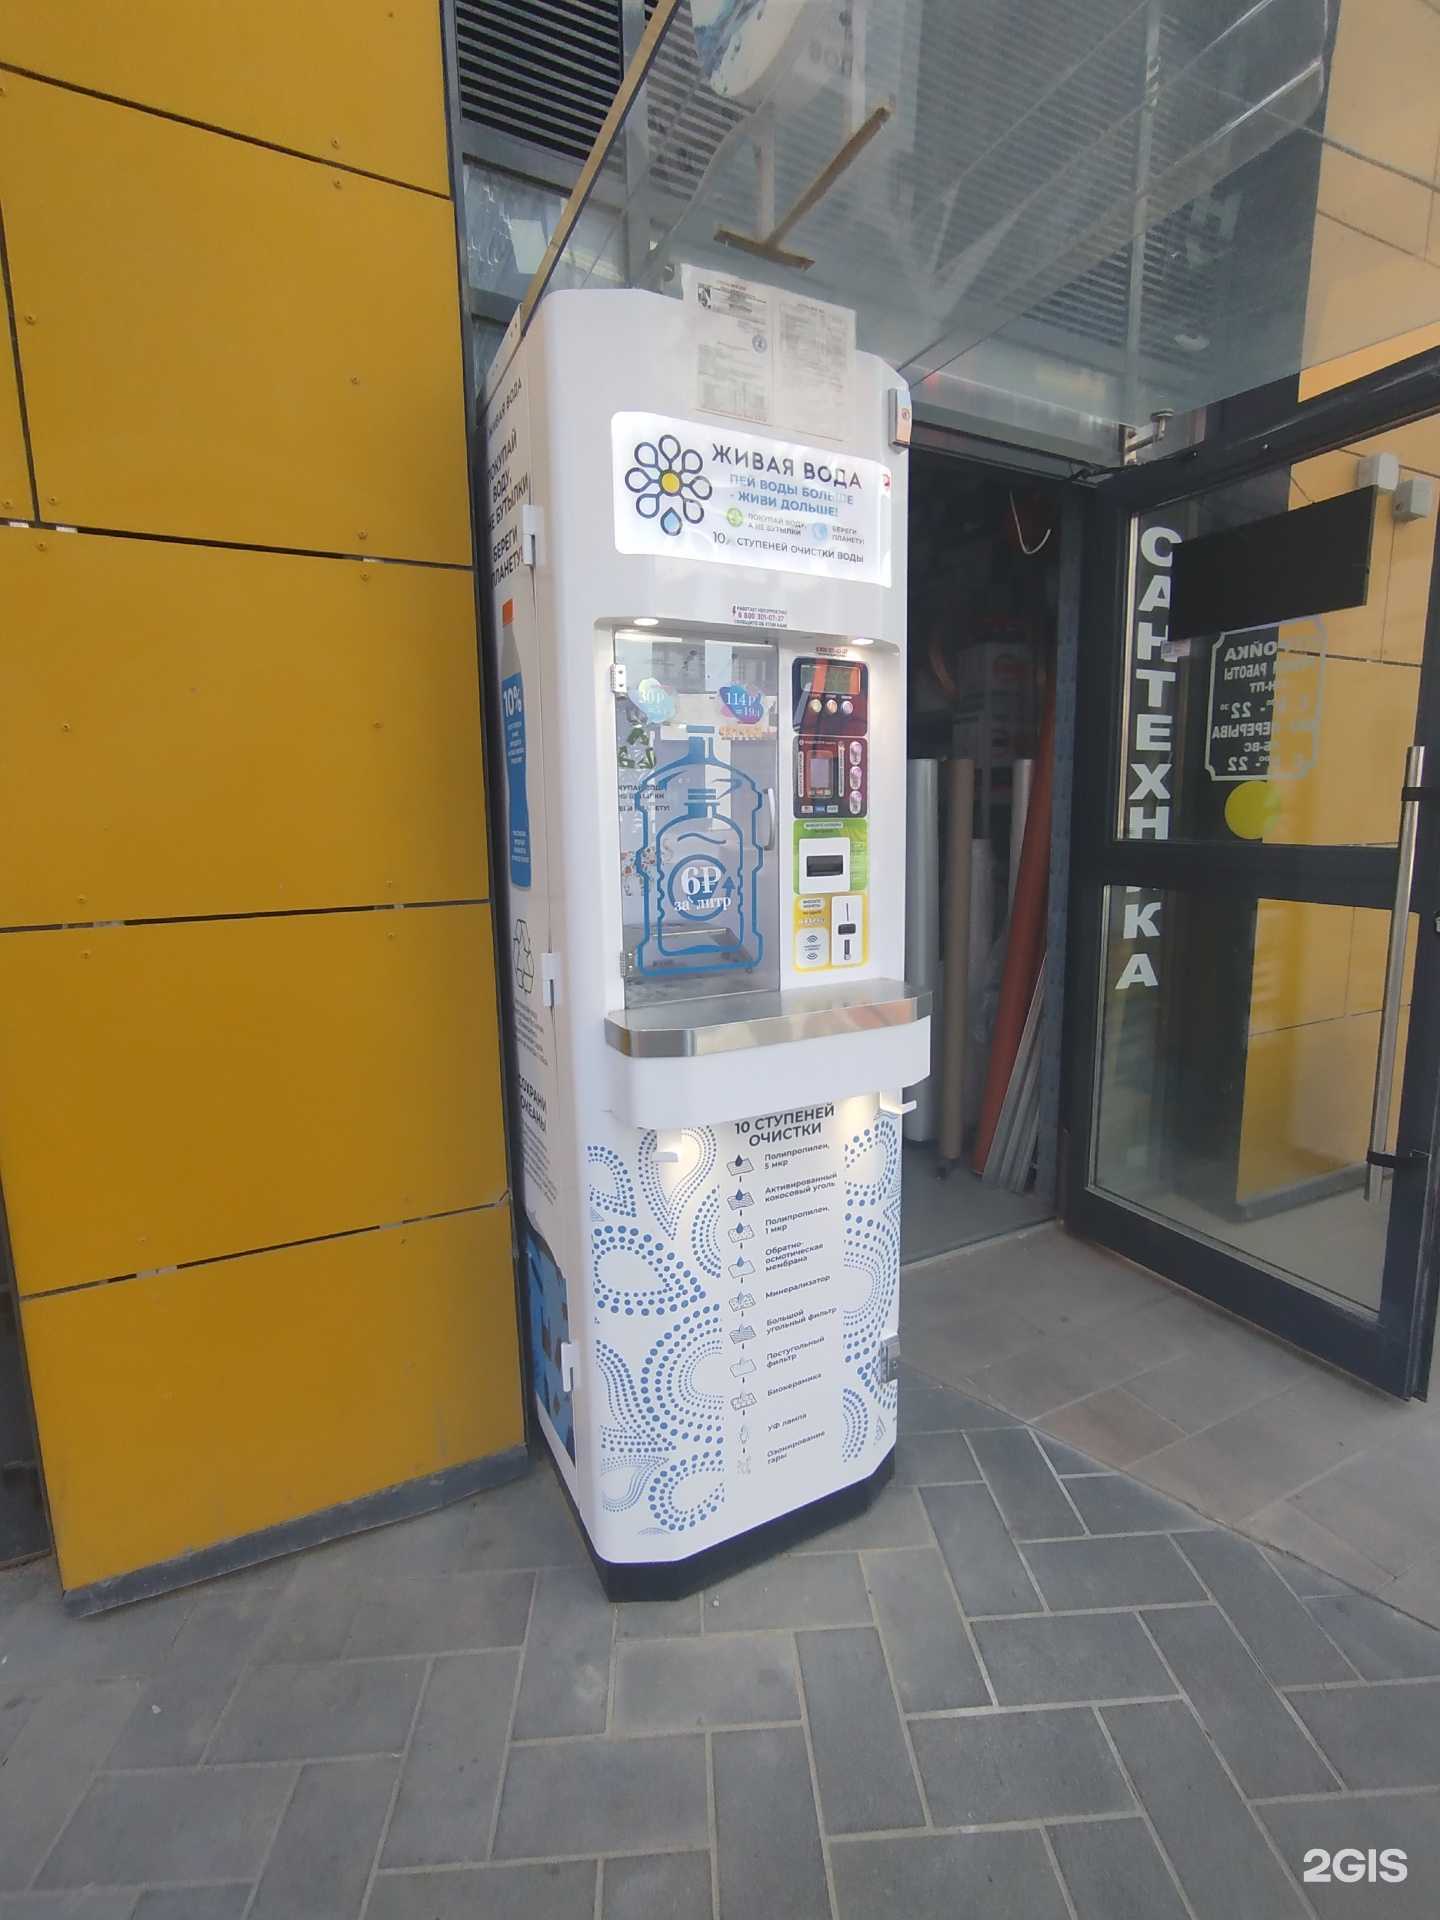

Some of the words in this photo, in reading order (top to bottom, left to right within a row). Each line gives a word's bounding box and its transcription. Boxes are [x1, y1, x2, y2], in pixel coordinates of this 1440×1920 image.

[505, 377, 522, 409] ВОДА
[711, 443, 794, 477] ЖИВАЯ
[803, 462, 863, 489] ВОДА
[493, 467, 512, 503] ВОДУ,
[729, 473, 756, 489] ПЕЙ
[759, 480, 798, 497] ВОДЫ
[495, 471, 529, 525] БУТЫЛКИ
[737, 490, 777, 508] ЖИВИ
[781, 499, 839, 517] ДОЛЬШЕ!
[747, 512, 784, 525] ПОКУПАЙ
[753, 523, 764, 531] НЕ
[766, 525, 801, 536] БУТЫЛКИ
[493, 525, 518, 562] БЕРЕГИ
[736, 537, 788, 552] СТУПЕНЕЙ
[790, 545, 836, 559] ОЧИСТКИ
[837, 551, 864, 563] ВОДЫ
[502, 685, 522, 716] 10%
[1115, 526, 1183, 990] САНТЕХНКА
[674, 898, 691, 911] за
[696, 896, 732, 911] литр
[520, 1094, 546, 1133] ОКЕАНЫ
[734, 1120, 750, 1135] 10
[754, 1103, 835, 1131] СТУПЕНЕЙ
[749, 1122, 822, 1147] ОЧИСТКИ
[764, 1143, 830, 1162] Полипропилен,
[764, 1162, 770, 1170] 5
[771, 1159, 789, 1170] мкр
[764, 1188, 811, 1203] кокосовый
[812, 1182, 836, 1193] уголь
[765, 1172, 838, 1195] Активированный
[765, 1206, 830, 1227] Полипропилен,
[770, 1223, 788, 1234] мкр
[765, 1241, 804, 1257] Обратно-
[765, 1244, 824, 1265] осмотическая
[765, 1256, 808, 1273] мембрана
[765, 1275, 831, 1300] Минерализатор
[766, 1309, 804, 1327] Большой
[766, 1316, 807, 1336] угольный
[808, 1306, 837, 1322] фильтр
[766, 1336, 825, 1361] Постугольный
[766, 1353, 798, 1369] фильтр
[767, 1372, 822, 1397] Биокерамика
[782, 1413, 807, 1426] лампа
[767, 1430, 825, 1458] Озонирование
[767, 1452, 788, 1465] тары
